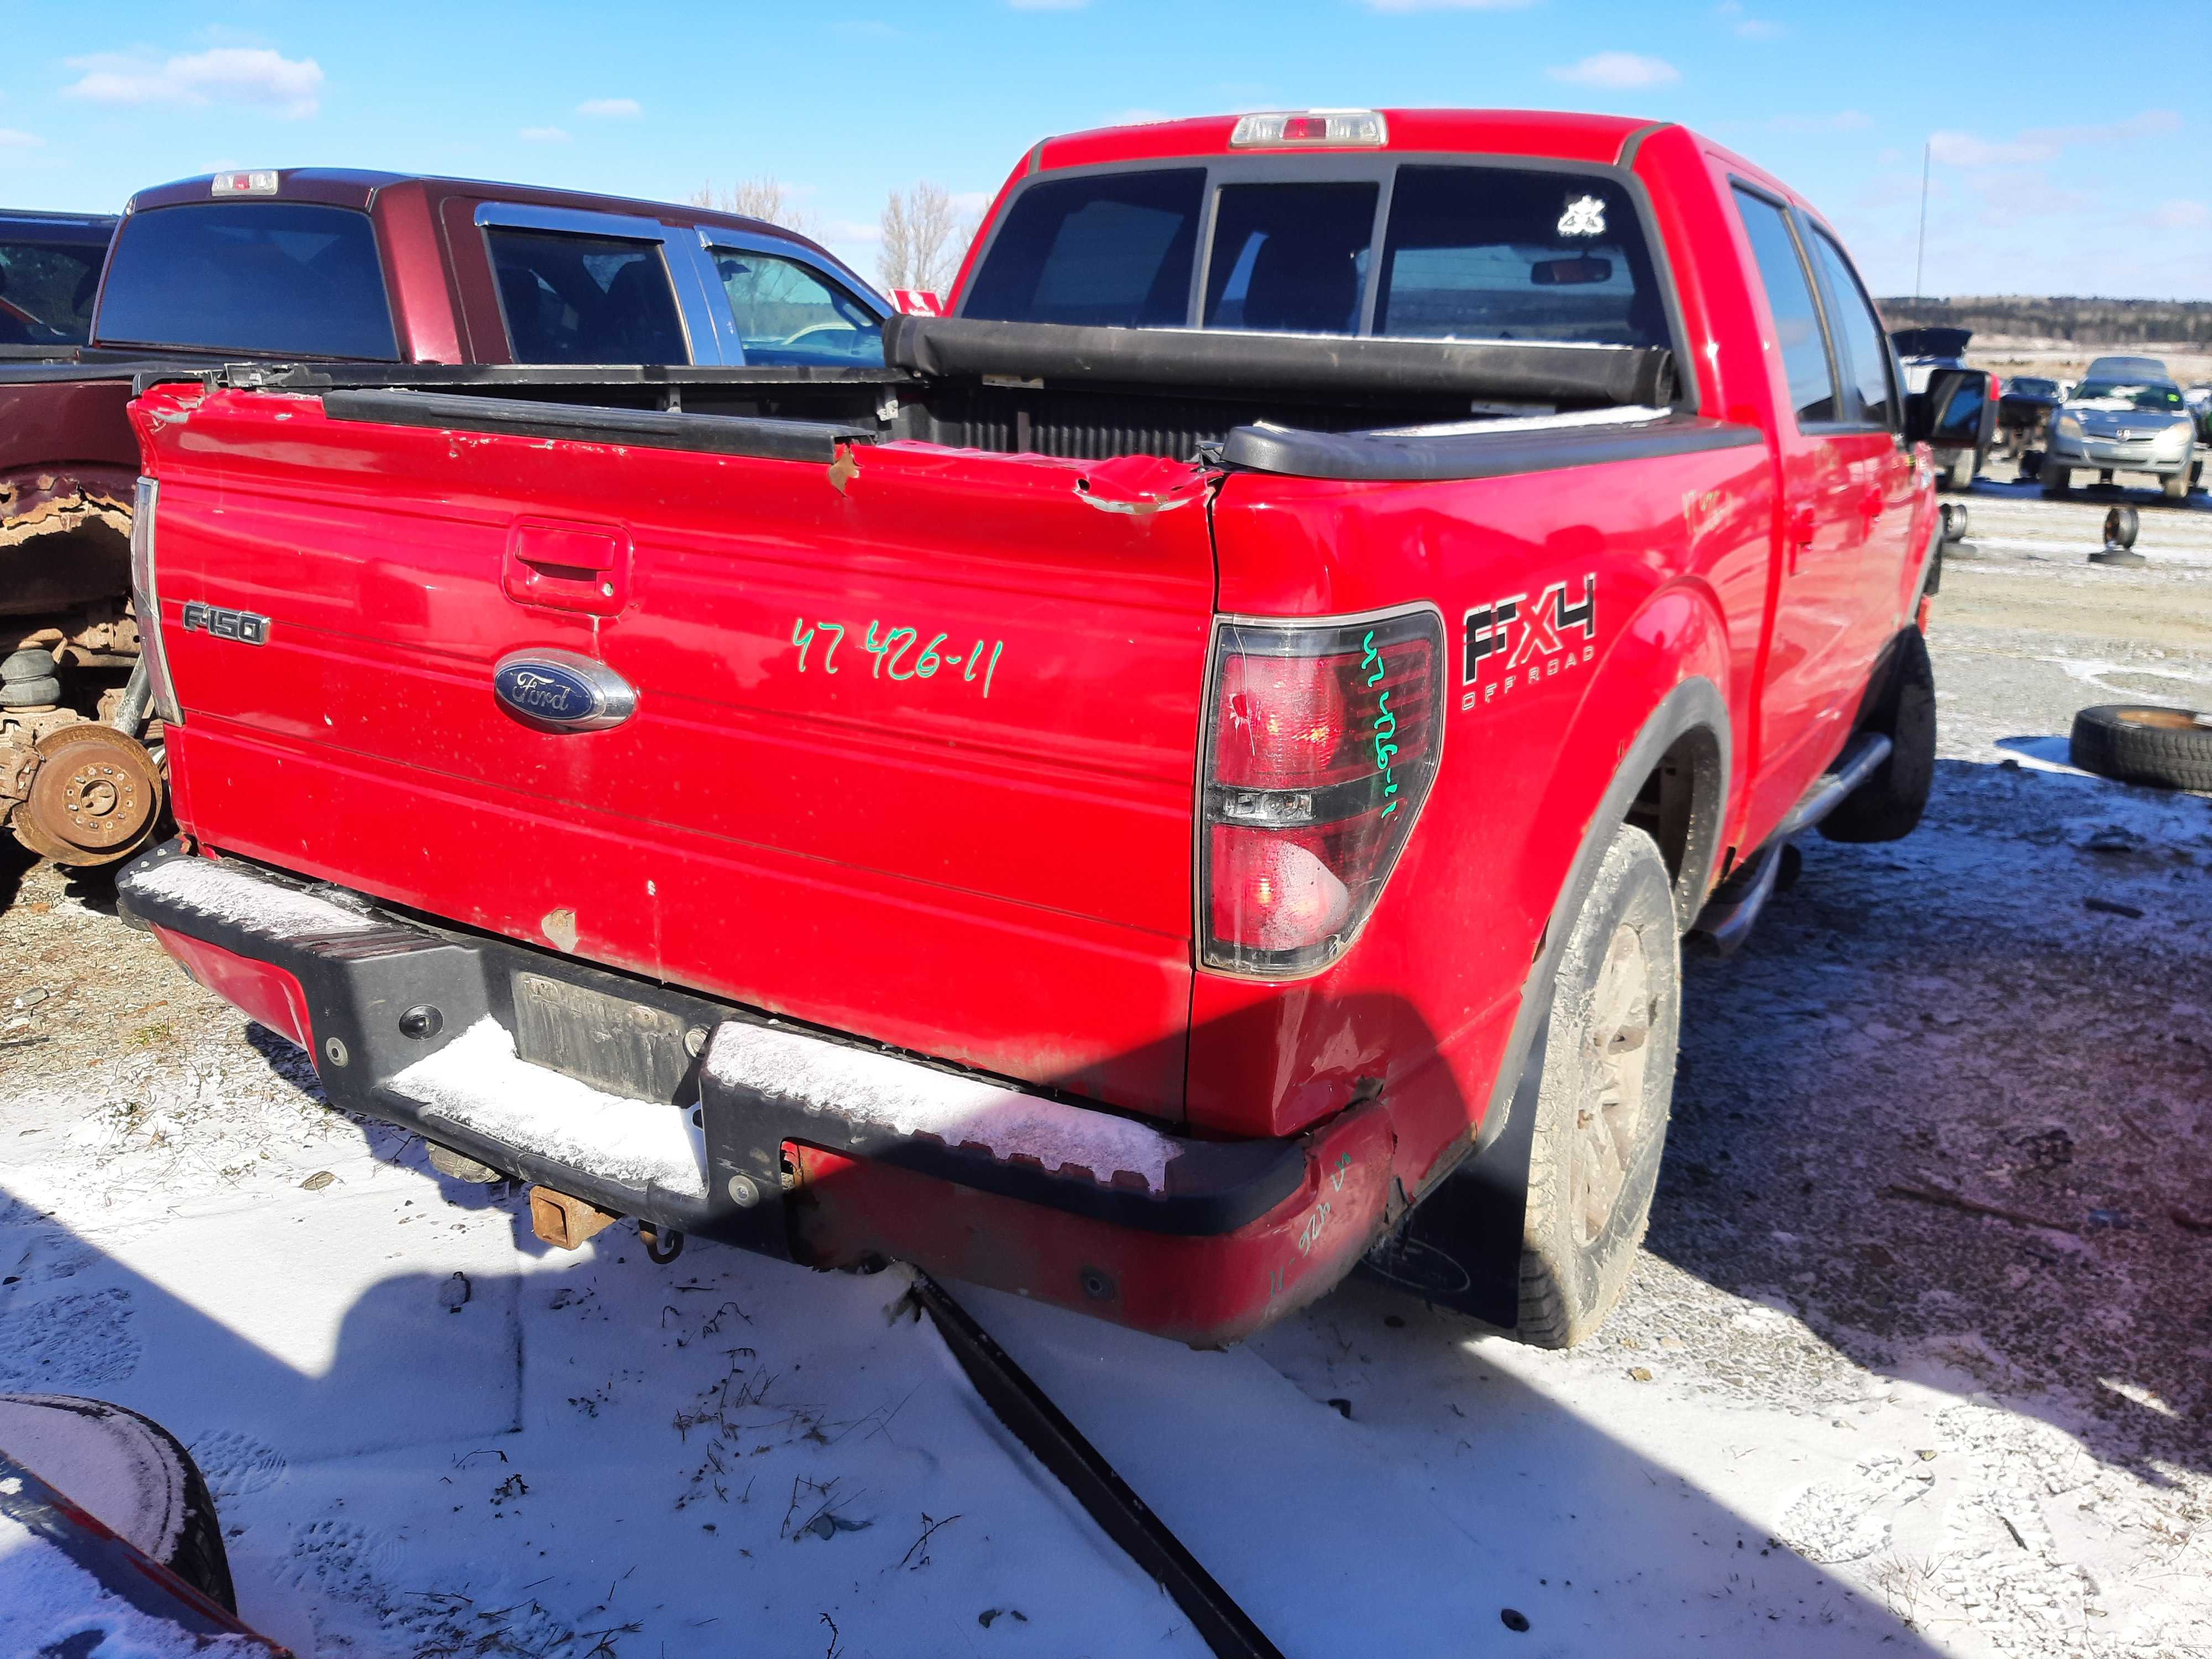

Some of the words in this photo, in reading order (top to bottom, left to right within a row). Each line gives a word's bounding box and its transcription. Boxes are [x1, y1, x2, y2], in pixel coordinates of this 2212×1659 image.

[792, 618, 844, 672] 47
[1463, 572, 1595, 686] FX4
[512, 672, 570, 712] Ford
[1463, 676, 1516, 711] OFF
[1528, 646, 1594, 684] ROAD
